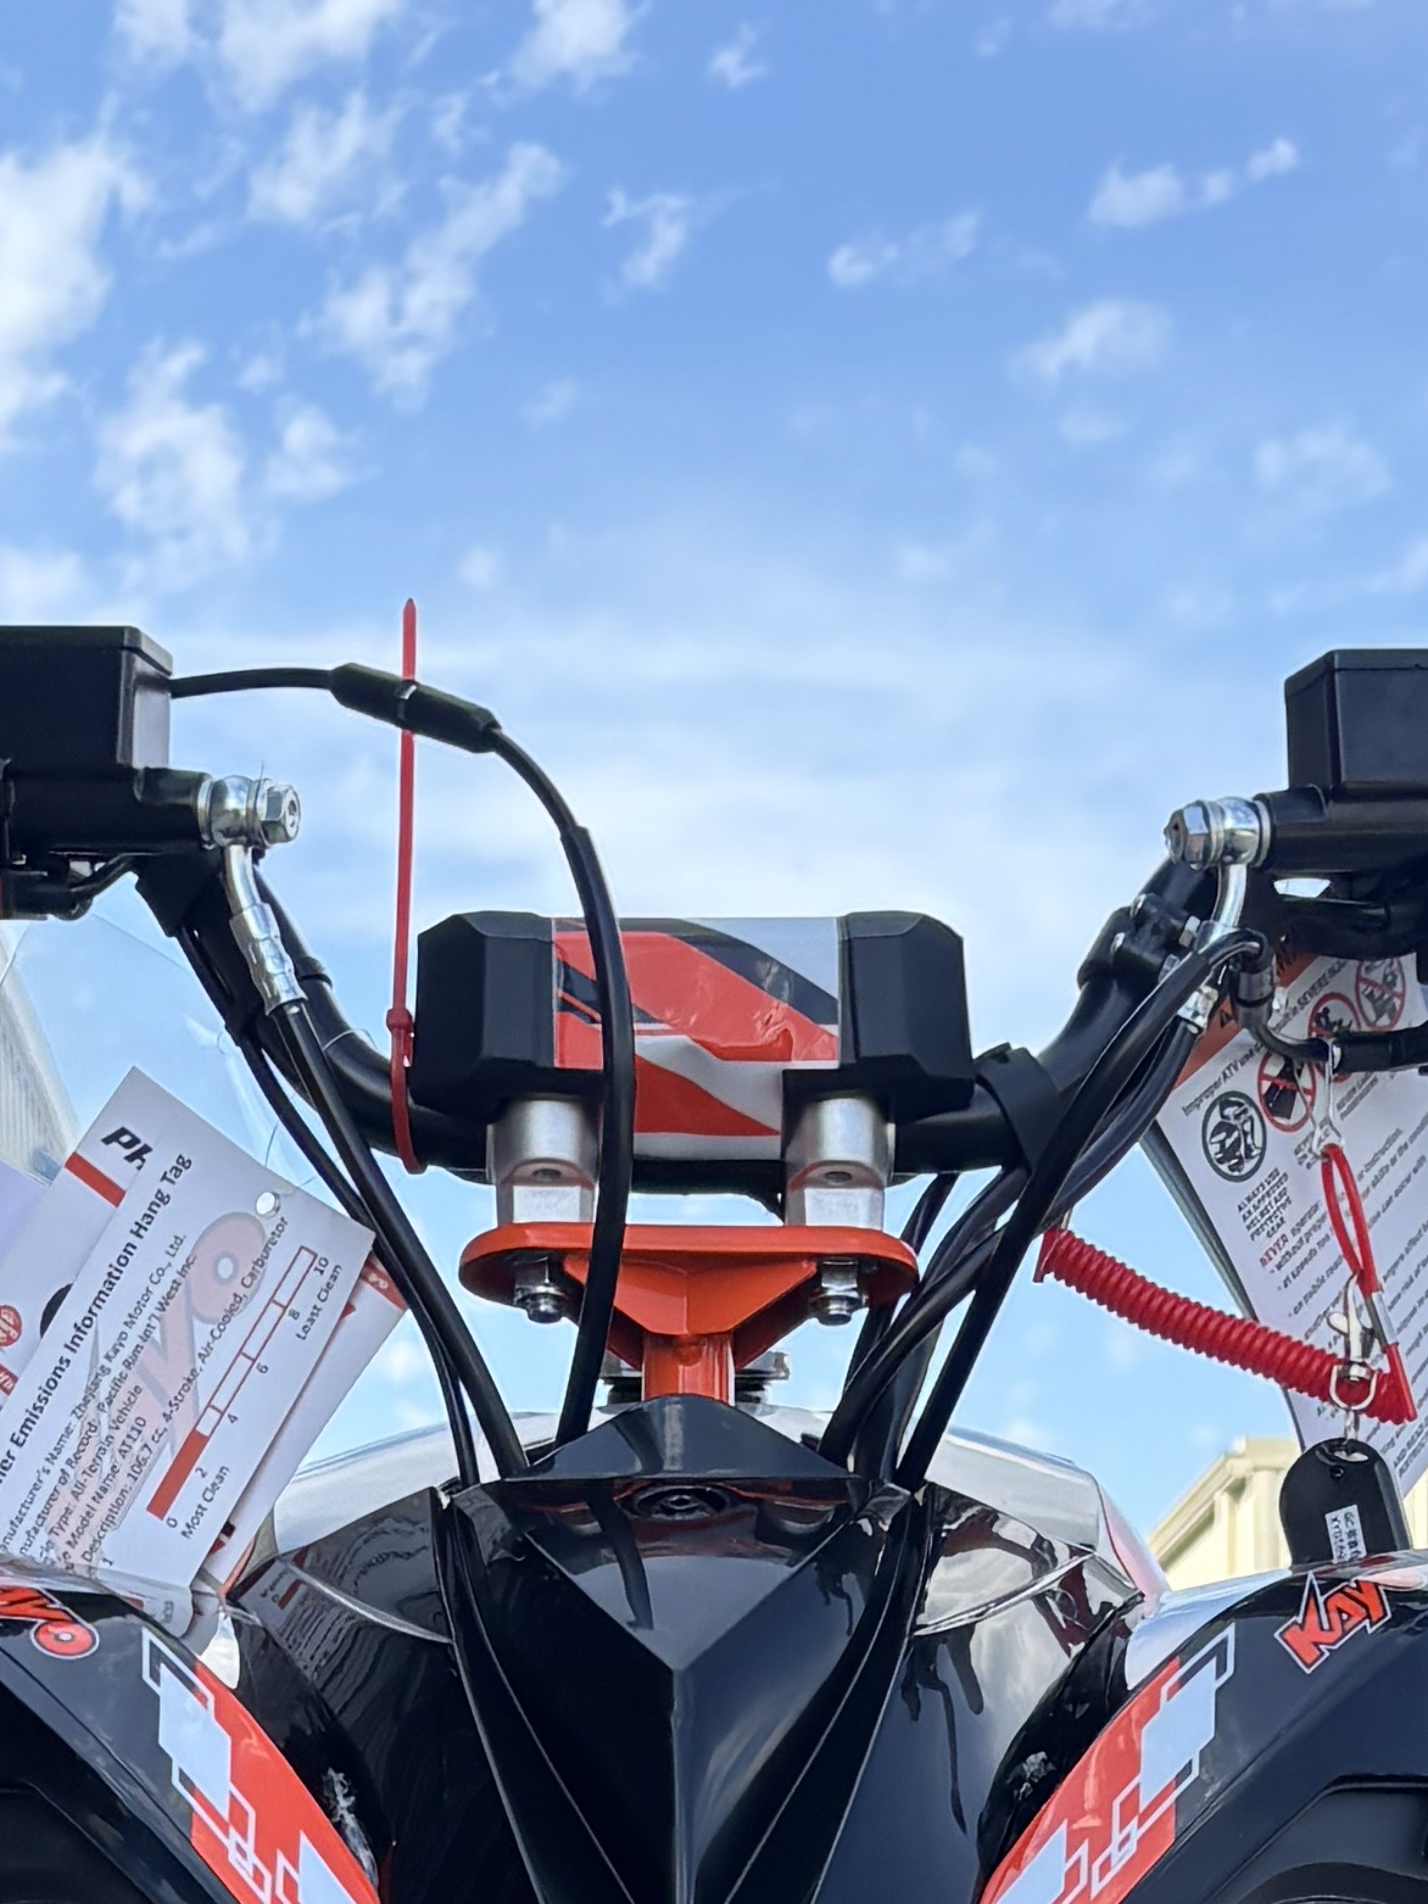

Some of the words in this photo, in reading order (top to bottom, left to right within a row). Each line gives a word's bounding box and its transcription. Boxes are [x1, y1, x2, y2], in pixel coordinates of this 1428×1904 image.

[10, 1356, 71, 1448] Emissions
[64, 1242, 137, 1353] Information
[129, 1188, 171, 1239] Hang
[159, 1154, 192, 1185] Tag
[103, 1330, 129, 1363] Kayo
[122, 1286, 153, 1329] Motor
[295, 1304, 323, 1341] Least
[316, 1264, 343, 1303] Clean
[57, 1467, 71, 1486] of
[96, 1371, 129, 1413] Pacific
[121, 1343, 145, 1371] Rim
[155, 1279, 182, 1313] West
[70, 1434, 115, 1502] All-Terrain
[108, 1385, 143, 1431] Vehicle
[81, 1484, 133, 1563] Description:
[240, 1216, 288, 1289] Carburetor
[166, 1517, 178, 1529] 0
[195, 1467, 208, 1479] 2
[227, 1413, 239, 1424] 4
[256, 1363, 269, 1374] 6
[288, 1309, 301, 1321] 8
[313, 1256, 329, 1276] 10
[65, 1503, 97, 1549] Model
[117, 1416, 147, 1460] AT110
[180, 1503, 208, 1539] Most
[201, 1465, 230, 1503] Clean
